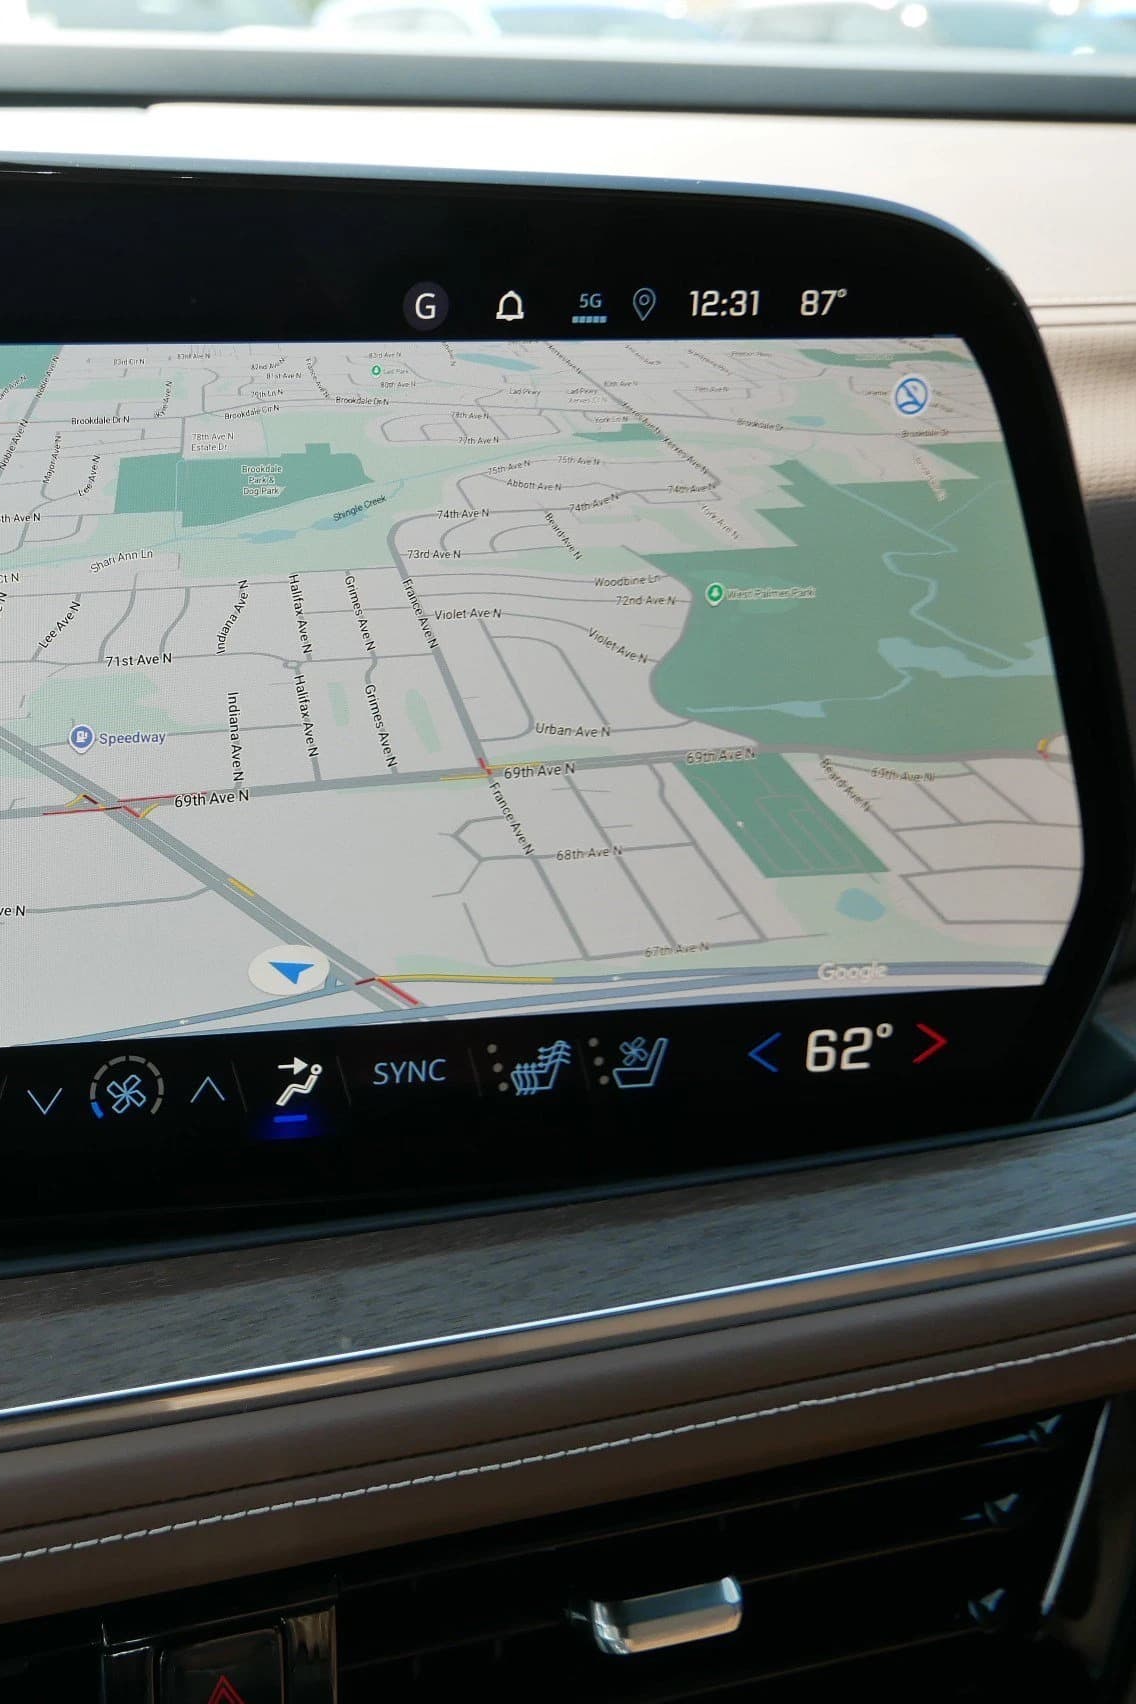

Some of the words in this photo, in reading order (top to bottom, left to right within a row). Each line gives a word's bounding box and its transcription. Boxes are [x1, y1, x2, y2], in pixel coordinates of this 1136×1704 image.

[415, 293, 436, 319] G
[579, 293, 602, 308] 5G
[689, 290, 759, 317] 12:31
[112, 416, 122, 424] Dr
[248, 476, 266, 484] Park
[244, 487, 260, 496] Dog
[14, 513, 32, 522] Ave
[33, 512, 40, 522] N
[333, 502, 364, 522] Shingle
[364, 495, 386, 510] Creek
[437, 509, 460, 518] 74th
[462, 510, 480, 518] Ave
[482, 508, 490, 517] N
[408, 550, 430, 559] 73rd
[433, 550, 450, 558] Ave
[452, 550, 460, 558] N
[11, 573, 19, 582] N
[238, 580, 247, 589] N
[233, 592, 248, 614] Ave
[288, 574, 303, 616] Halifax
[345, 576, 362, 617] Grimes
[358, 618, 372, 643] Ave
[365, 640, 376, 651] N
[403, 579, 422, 616] France
[418, 616, 434, 640] Ave
[428, 638, 439, 648] N
[435, 609, 466, 620] Violet
[470, 608, 490, 618] Ave
[492, 608, 501, 618] N
[39, 629, 57, 649] Lee
[56, 612, 74, 632] Ave
[68, 601, 80, 614] N
[297, 620, 308, 642] Ave
[217, 612, 237, 656] Indiana
[302, 643, 312, 654] N
[106, 656, 133, 667] 71st
[137, 655, 159, 666] Ave
[163, 654, 172, 664] N
[295, 675, 309, 718] Halifax
[228, 691, 240, 741] Indiana
[302, 721, 315, 744] Ave
[365, 684, 384, 729] Grimes
[378, 731, 392, 755] Ave
[386, 756, 397, 768] N
[535, 723, 572, 736] Urban
[575, 726, 597, 738] Ave
[601, 727, 610, 737] N
[100, 732, 166, 744] Speedway
[230, 744, 241, 768] Ave
[308, 746, 318, 757] N
[233, 771, 244, 781] N
[504, 767, 534, 780] 69th
[538, 765, 561, 776] Ave
[564, 763, 575, 774] N
[175, 794, 206, 808] 69th
[210, 792, 235, 804] Ave
[238, 790, 249, 802] N
[489, 782, 513, 822] France
[510, 821, 527, 846] Ave
[522, 844, 534, 855] N
[16, 906, 25, 916] N
[818, 963, 888, 980] Google
[372, 1058, 446, 1086] SYNC
